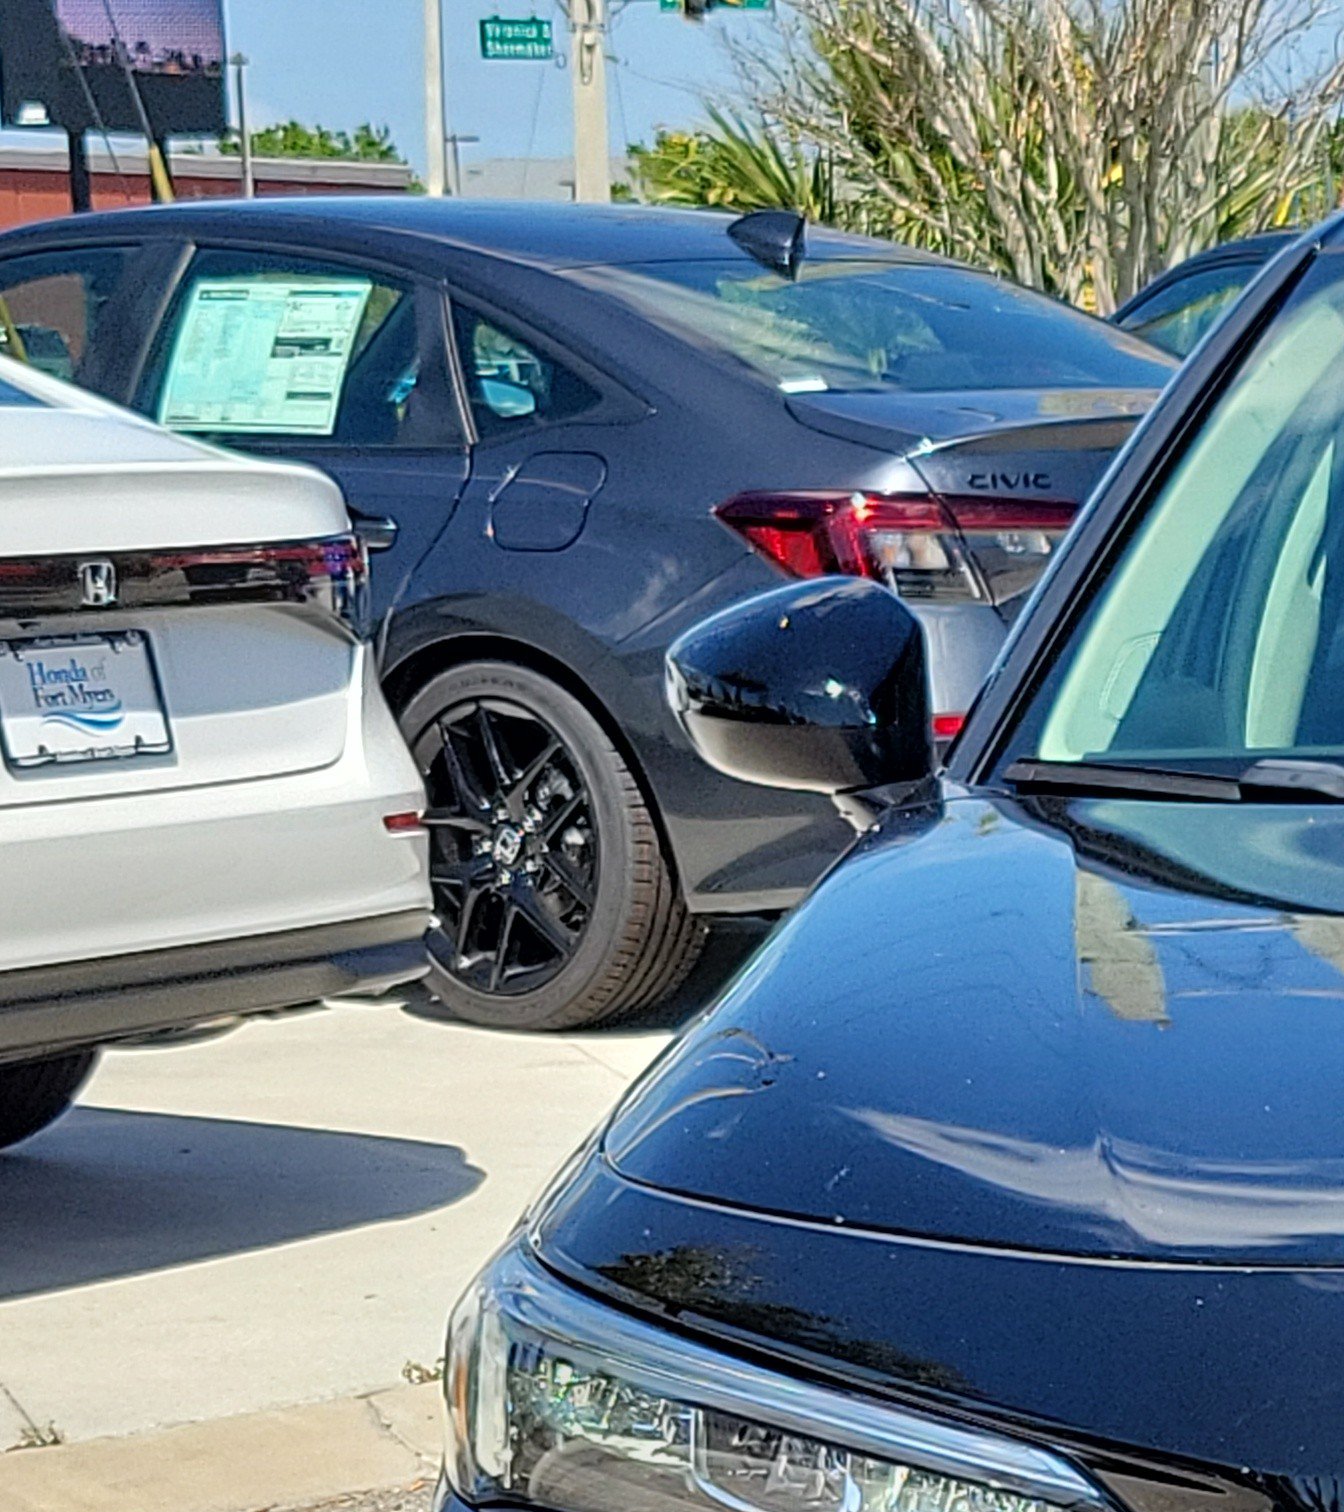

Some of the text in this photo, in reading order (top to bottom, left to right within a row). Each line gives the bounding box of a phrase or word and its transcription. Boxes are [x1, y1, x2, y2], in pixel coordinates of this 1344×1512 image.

[966, 472, 1052, 490] CIVIC
[26, 658, 88, 686] Honda
[33, 683, 115, 709] Fort Myers
